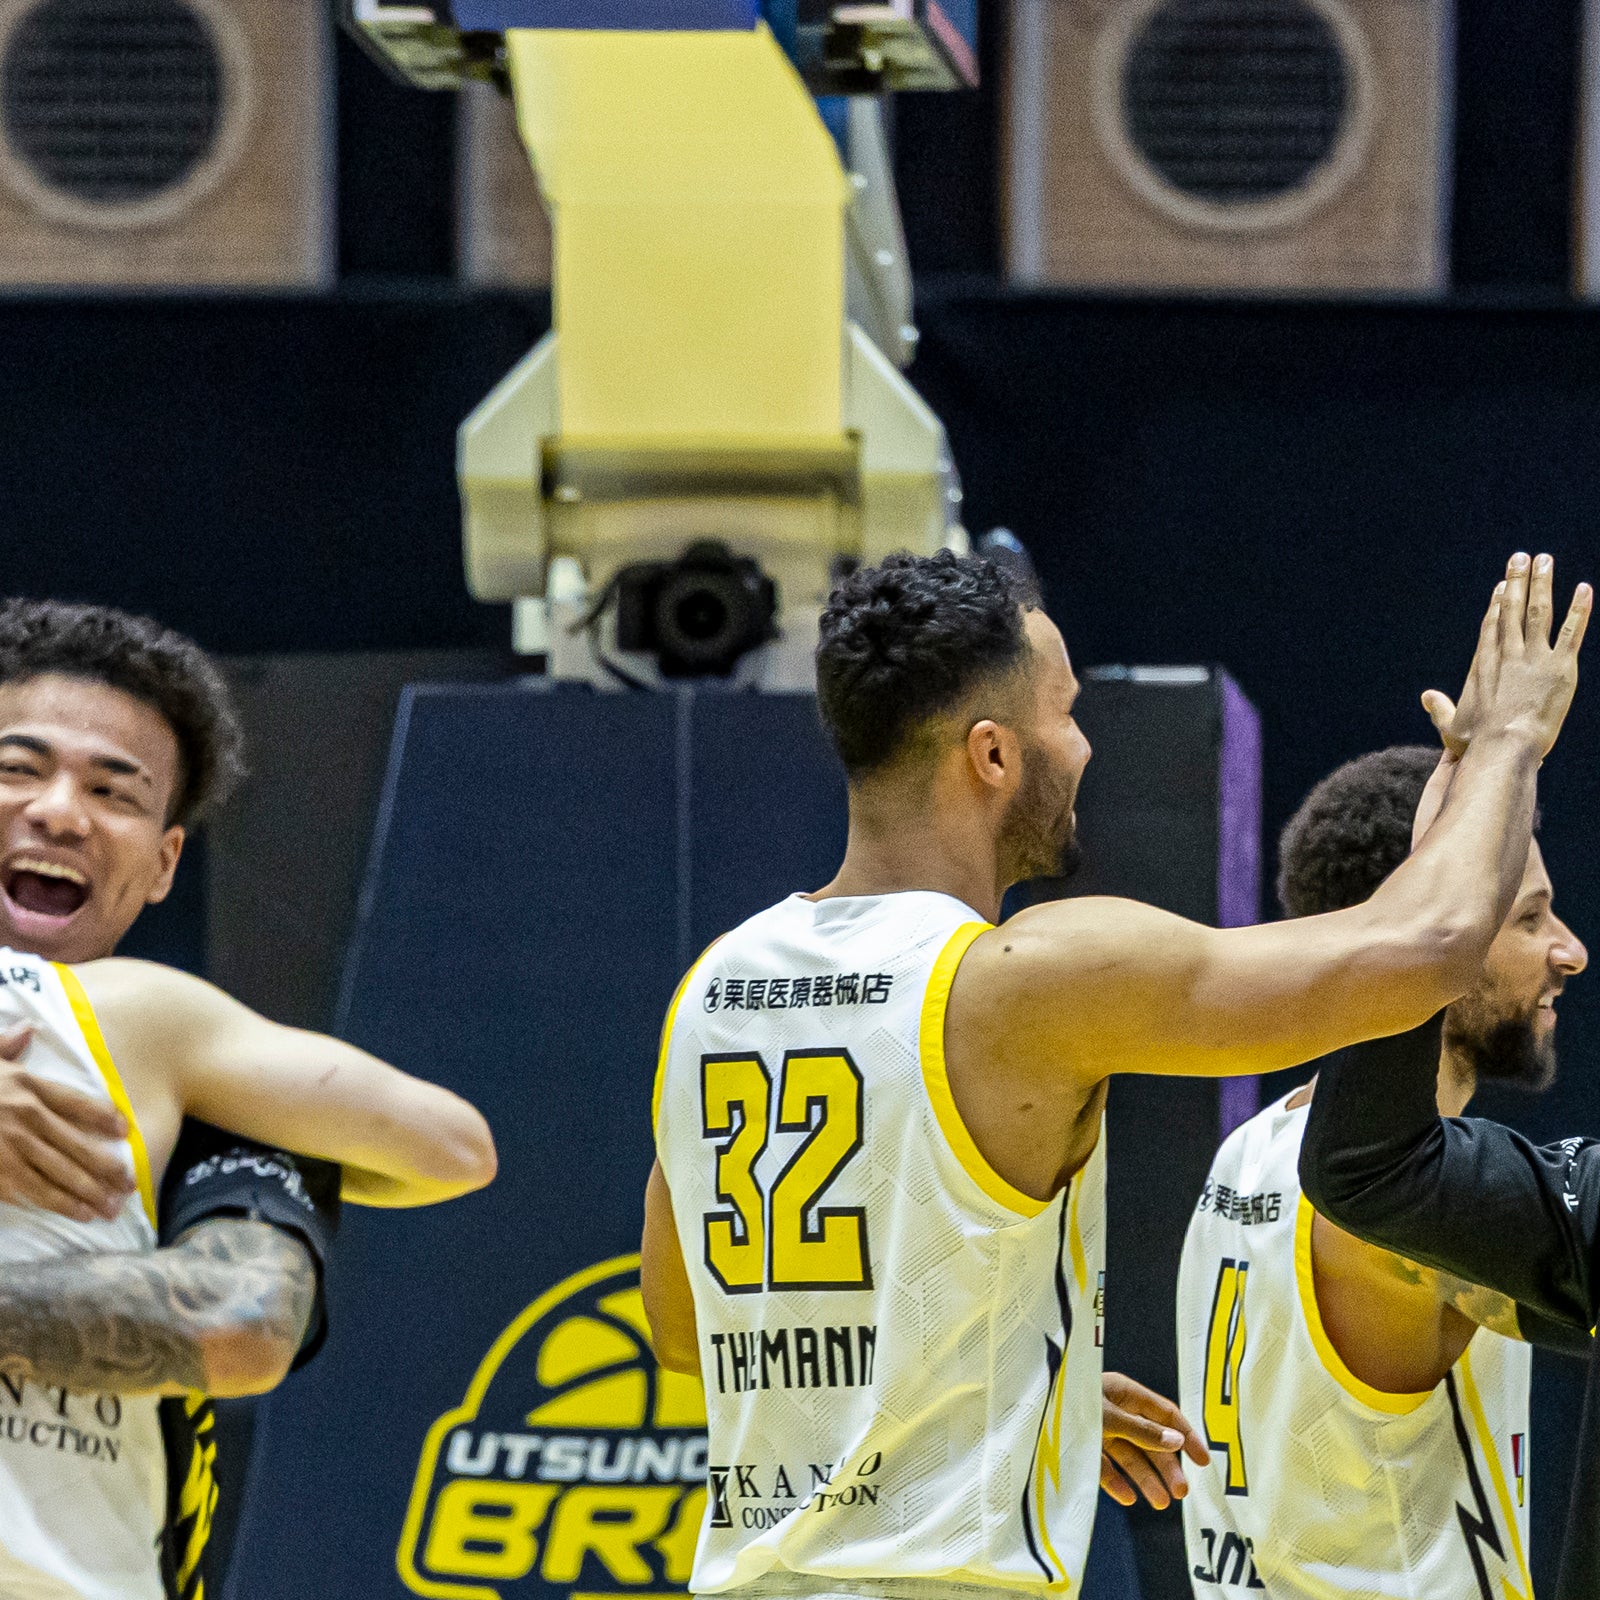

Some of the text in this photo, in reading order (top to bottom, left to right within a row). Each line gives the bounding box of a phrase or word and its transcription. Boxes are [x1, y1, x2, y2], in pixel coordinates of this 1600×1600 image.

[723, 972, 894, 1011] 栗原医療器械店
[700, 1047, 875, 1295] 32
[734, 1451, 882, 1498] KANO
